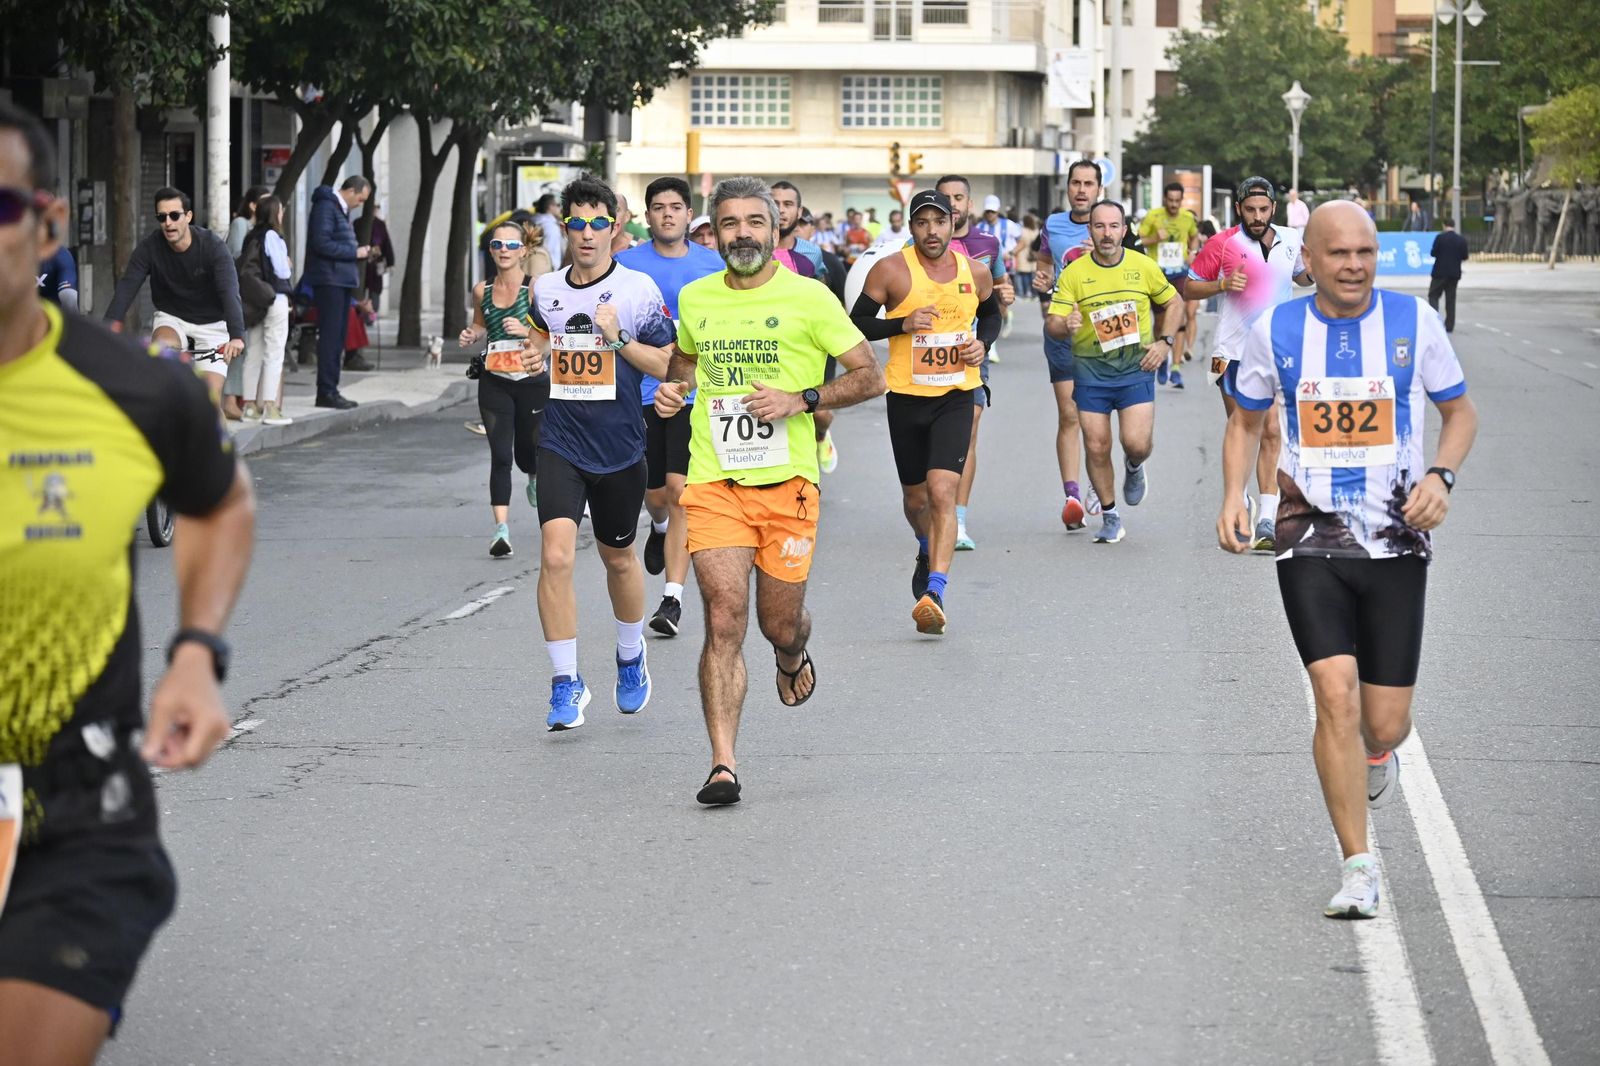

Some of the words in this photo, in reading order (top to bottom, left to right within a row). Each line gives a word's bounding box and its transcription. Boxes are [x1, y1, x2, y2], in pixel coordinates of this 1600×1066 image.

[1101, 313, 1131, 334] 326
[915, 335, 928, 344] 2K
[696, 341, 710, 352] TUS
[713, 353, 733, 364] NOS
[735, 353, 754, 364] DAN
[756, 353, 779, 363] VIDA
[921, 346, 959, 366] 490
[558, 351, 602, 375] 509
[727, 367, 744, 386] XI
[563, 386, 592, 395] Huelva
[1302, 381, 1321, 395] 2K
[1368, 380, 1387, 393] 2K
[712, 399, 725, 410] 2K
[1313, 401, 1379, 433] 382
[719, 415, 774, 442] 705
[727, 452, 763, 463] Huelva
[1324, 448, 1365, 459] Huelva
